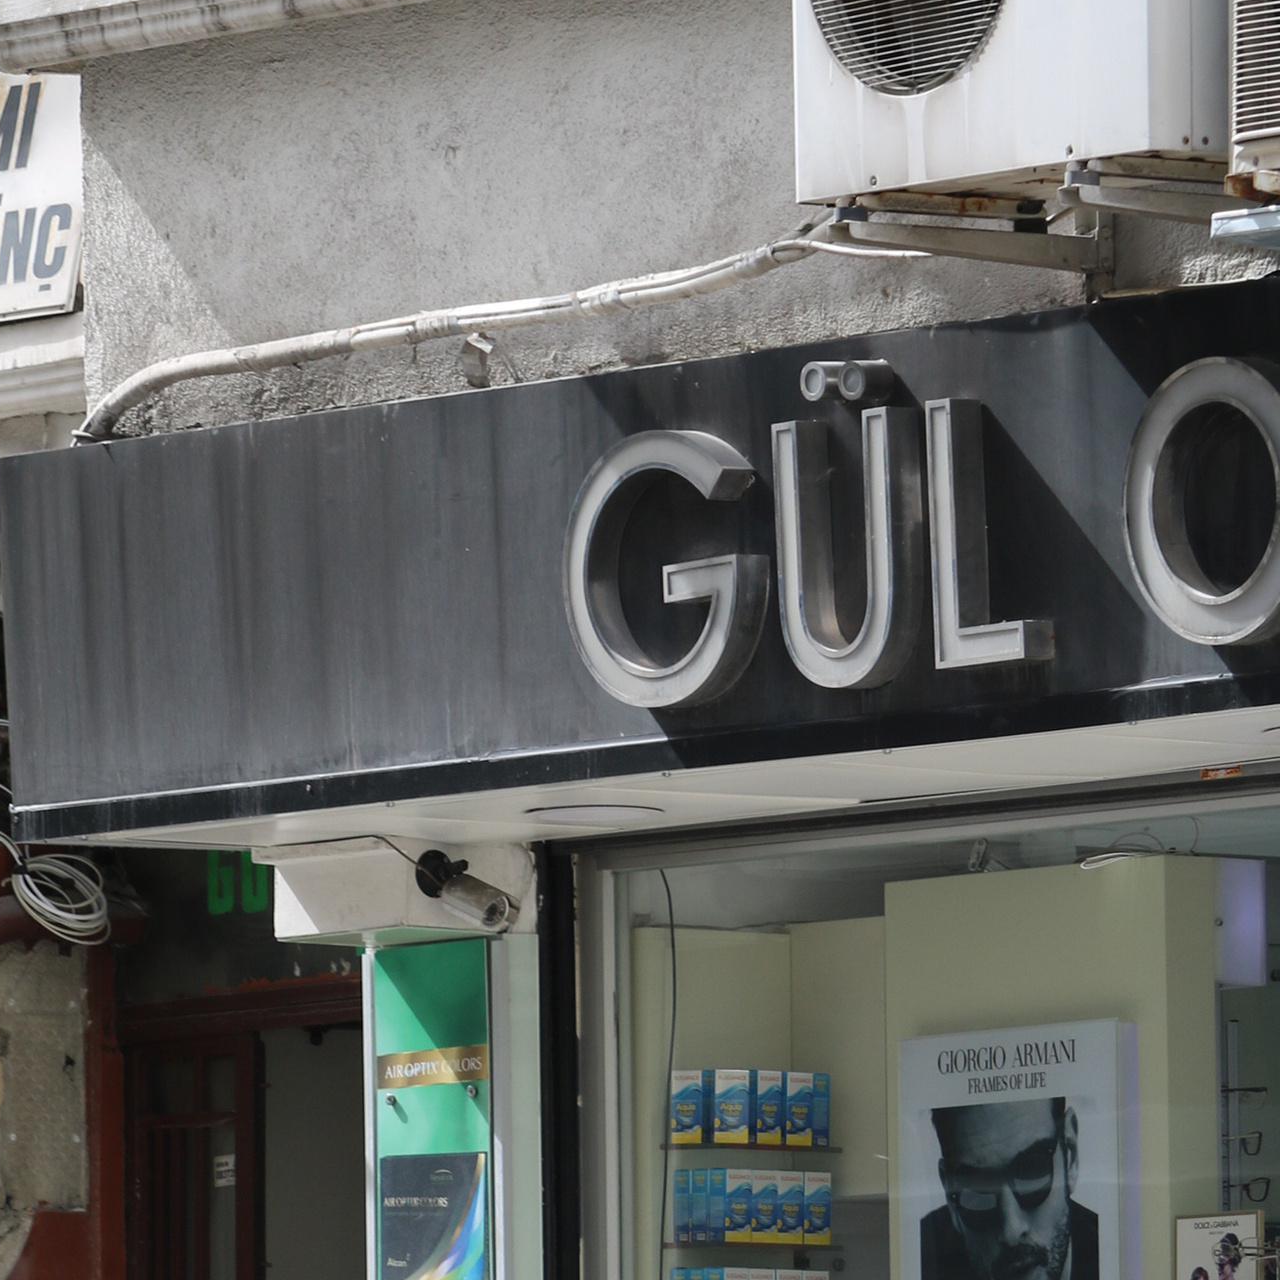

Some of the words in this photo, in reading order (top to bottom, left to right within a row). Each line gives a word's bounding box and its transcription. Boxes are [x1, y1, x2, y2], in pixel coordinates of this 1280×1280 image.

[563, 360, 1054, 708] GÜL
[441, 1057, 482, 1074] COLORS
[937, 1045, 1006, 1075] GIORGIO
[1012, 1039, 1076, 1068] ARMANI
[968, 1075, 1008, 1094] FRAMES
[1009, 1073, 1023, 1090] OF
[1025, 1071, 1046, 1089] LIFE
